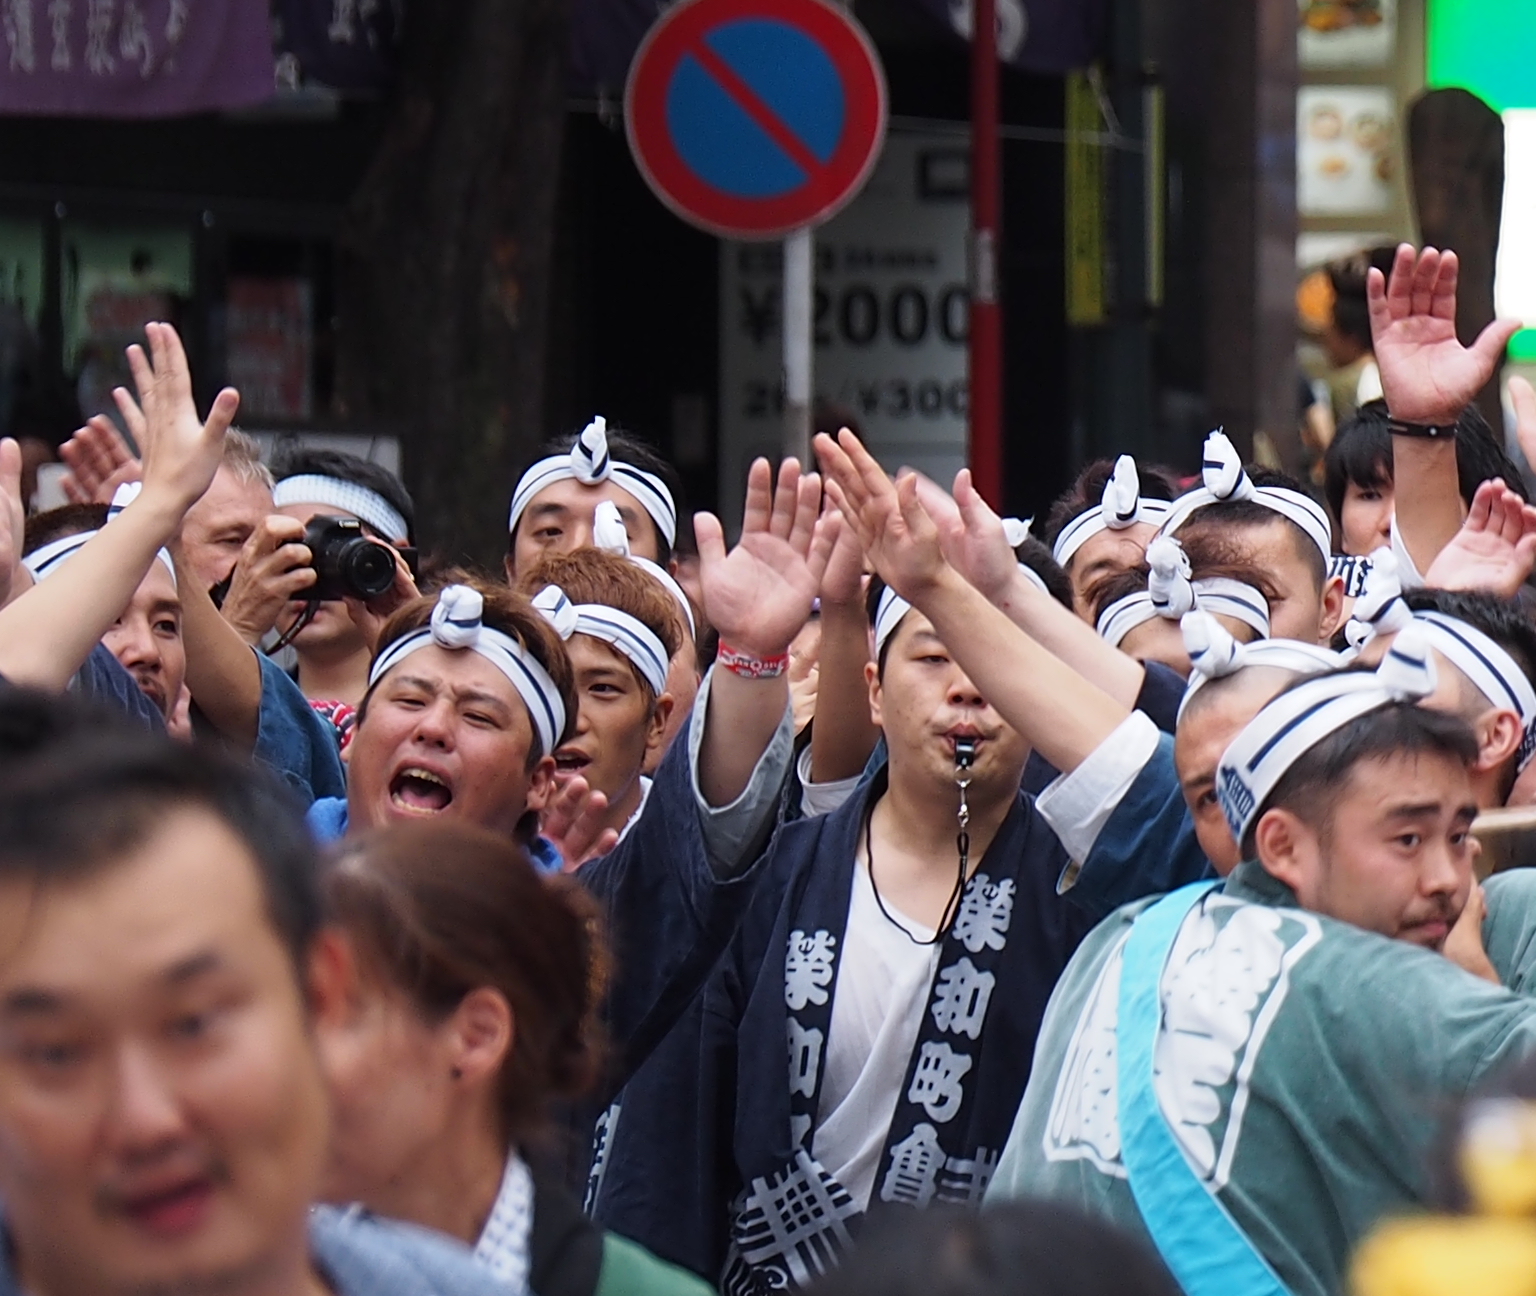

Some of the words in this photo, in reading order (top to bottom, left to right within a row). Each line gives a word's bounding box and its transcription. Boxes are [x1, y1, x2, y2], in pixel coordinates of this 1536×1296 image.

[784, 929, 837, 1148] 榮和
[881, 872, 1017, 1208] 榮和町會
